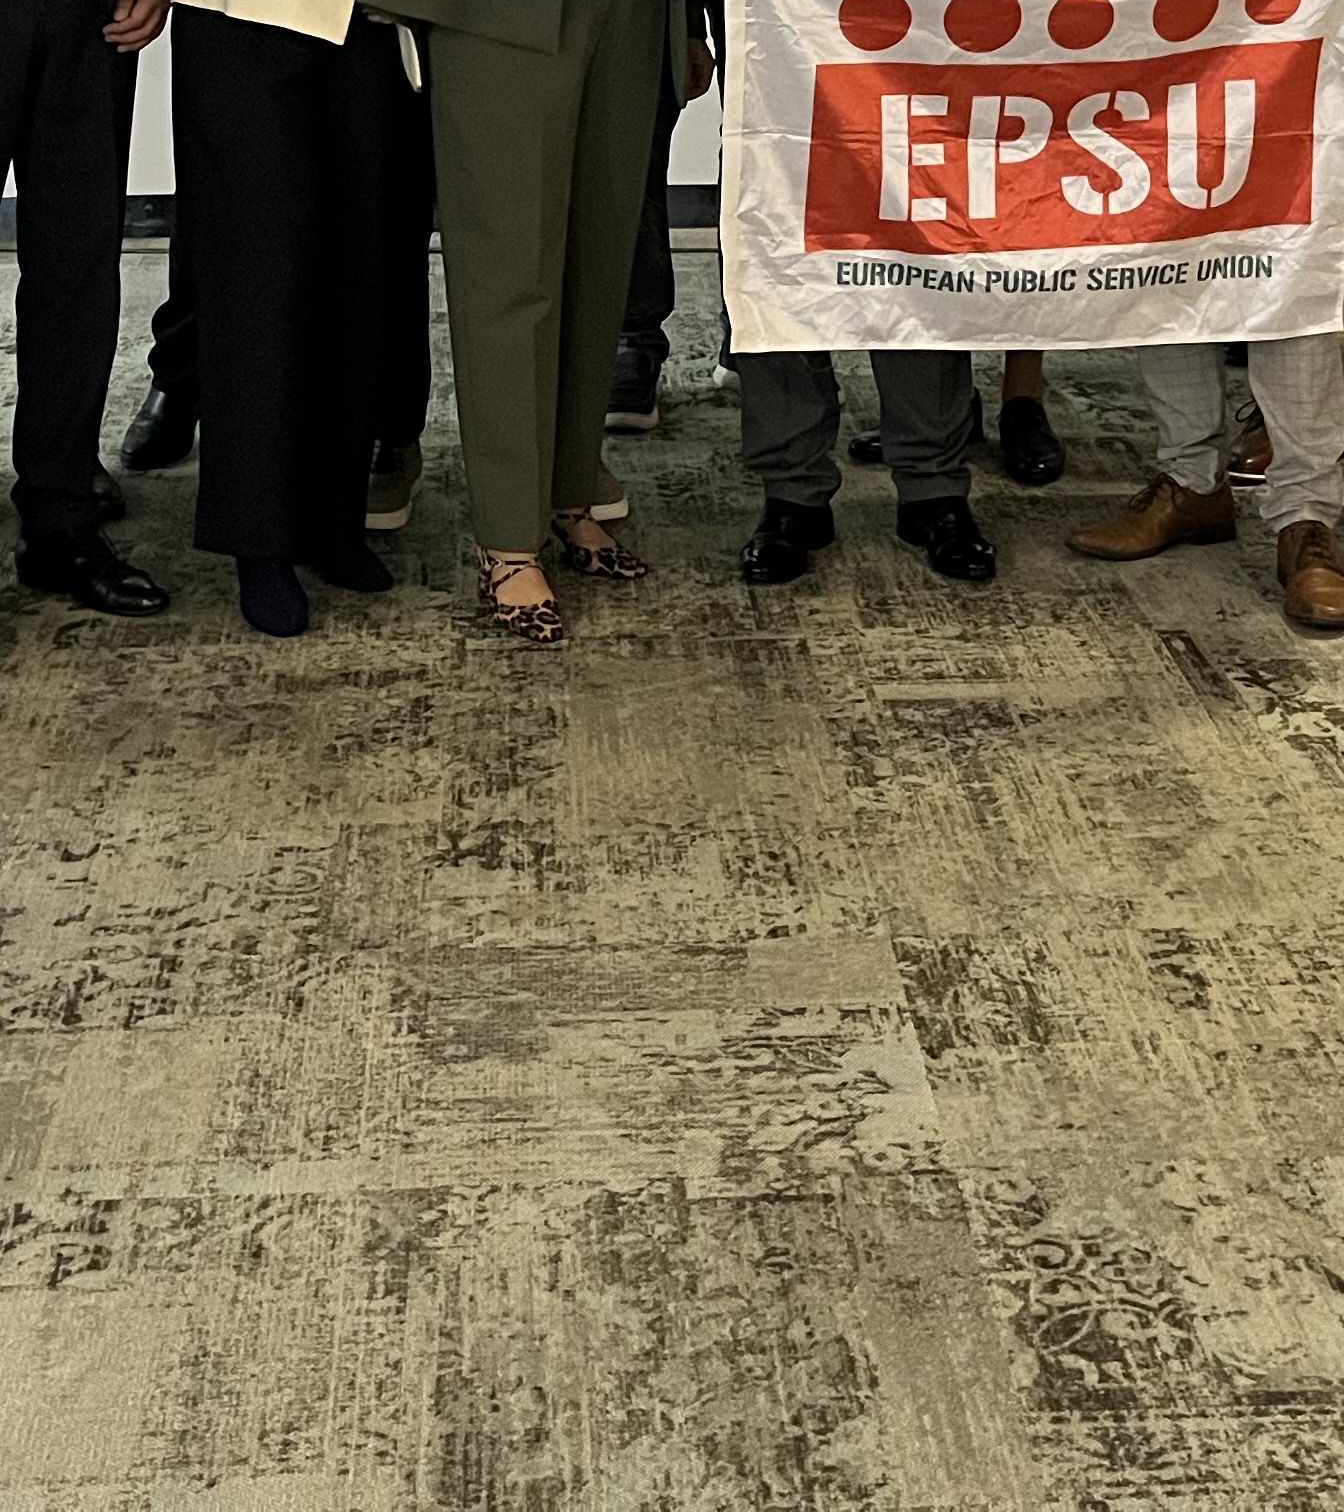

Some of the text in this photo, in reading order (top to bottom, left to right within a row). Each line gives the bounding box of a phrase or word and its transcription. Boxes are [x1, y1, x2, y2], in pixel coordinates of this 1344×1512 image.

[879, 79, 1256, 222] EPSU
[836, 255, 1273, 294] EUROPEAN PUBLIC SERVICE UNION
